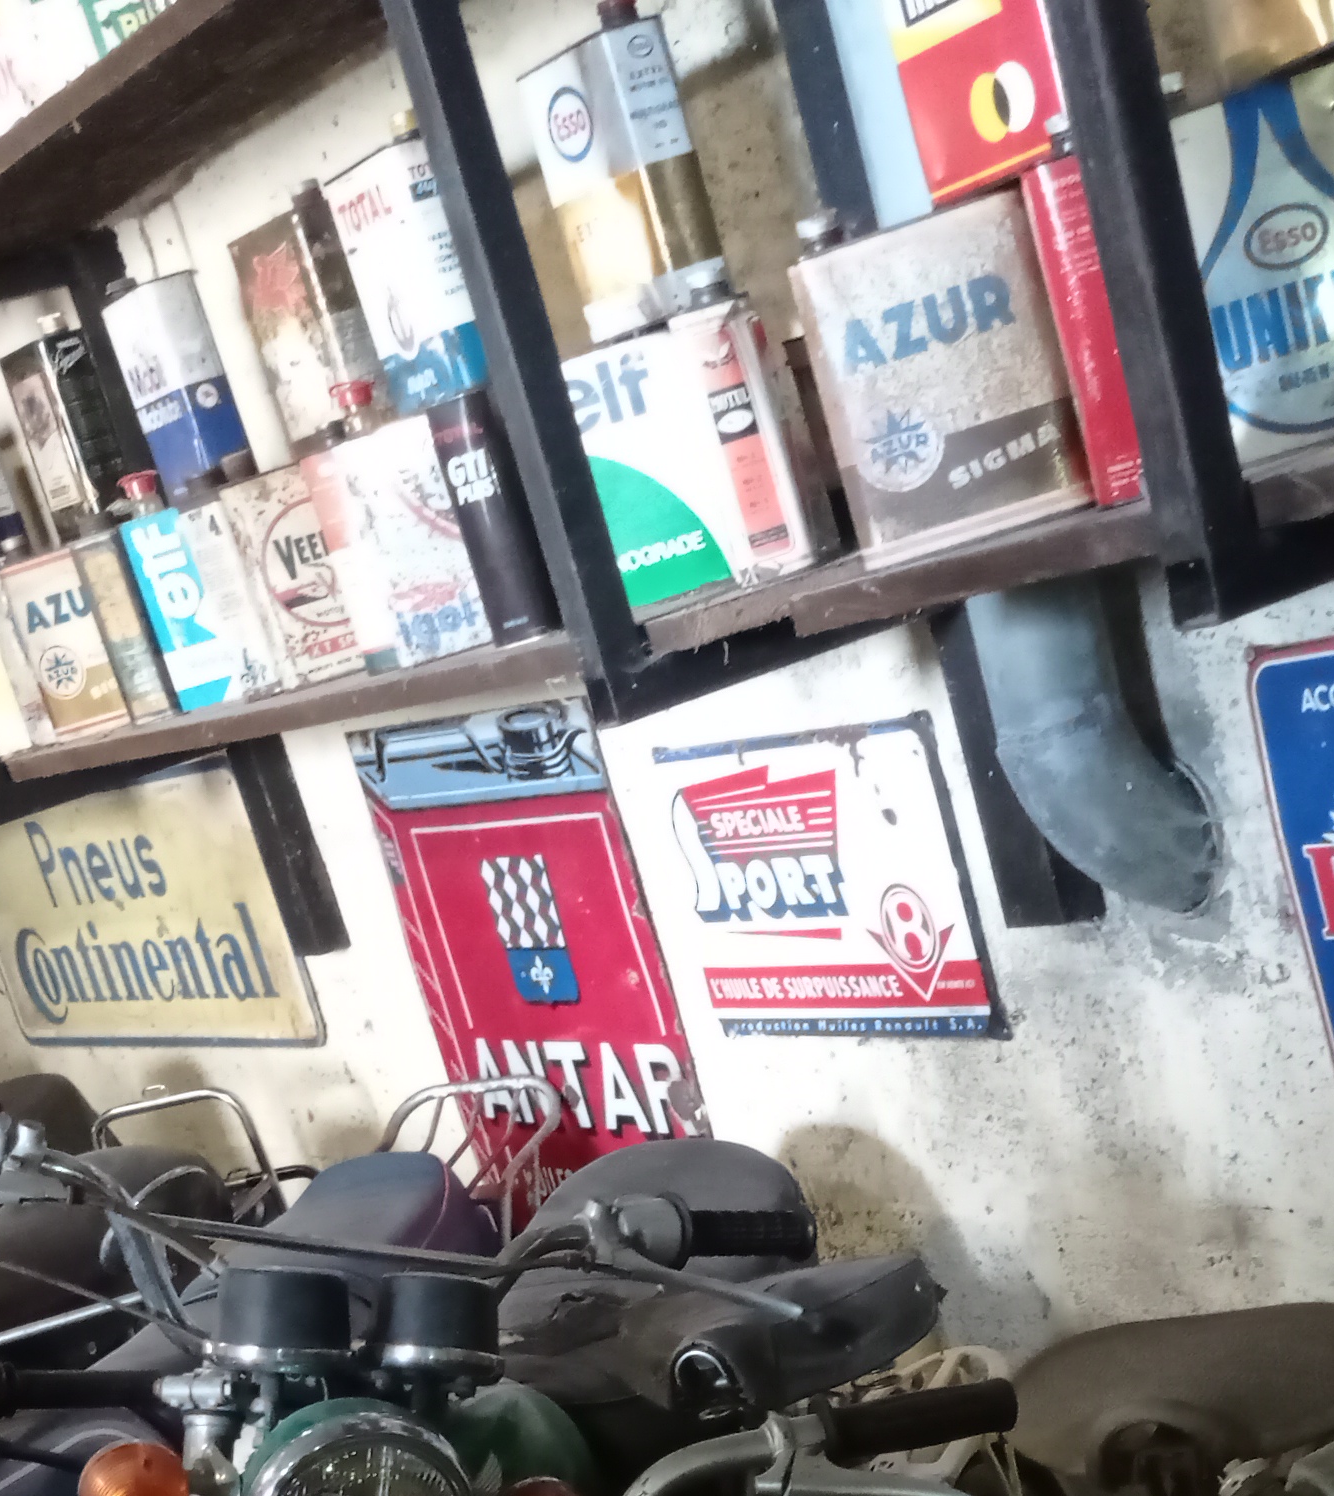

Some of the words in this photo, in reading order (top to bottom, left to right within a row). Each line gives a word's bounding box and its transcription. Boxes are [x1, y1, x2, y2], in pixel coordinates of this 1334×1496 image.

[842, 274, 1017, 377] AZUR
[564, 350, 650, 435] elf
[447, 447, 490, 487] GTI
[947, 419, 1063, 491] SIGMA
[456, 477, 496, 507] PLUS
[25, 585, 93, 635] AZU
[710, 805, 805, 838] SPECIALE
[23, 819, 168, 910] Pneus
[14, 902, 281, 1027] Continental
[709, 976, 763, 1000] L'HUILE
[762, 976, 785, 1000] DE
[783, 974, 904, 1000] SURPUISSANCE
[874, 1017, 939, 1032] Renault
